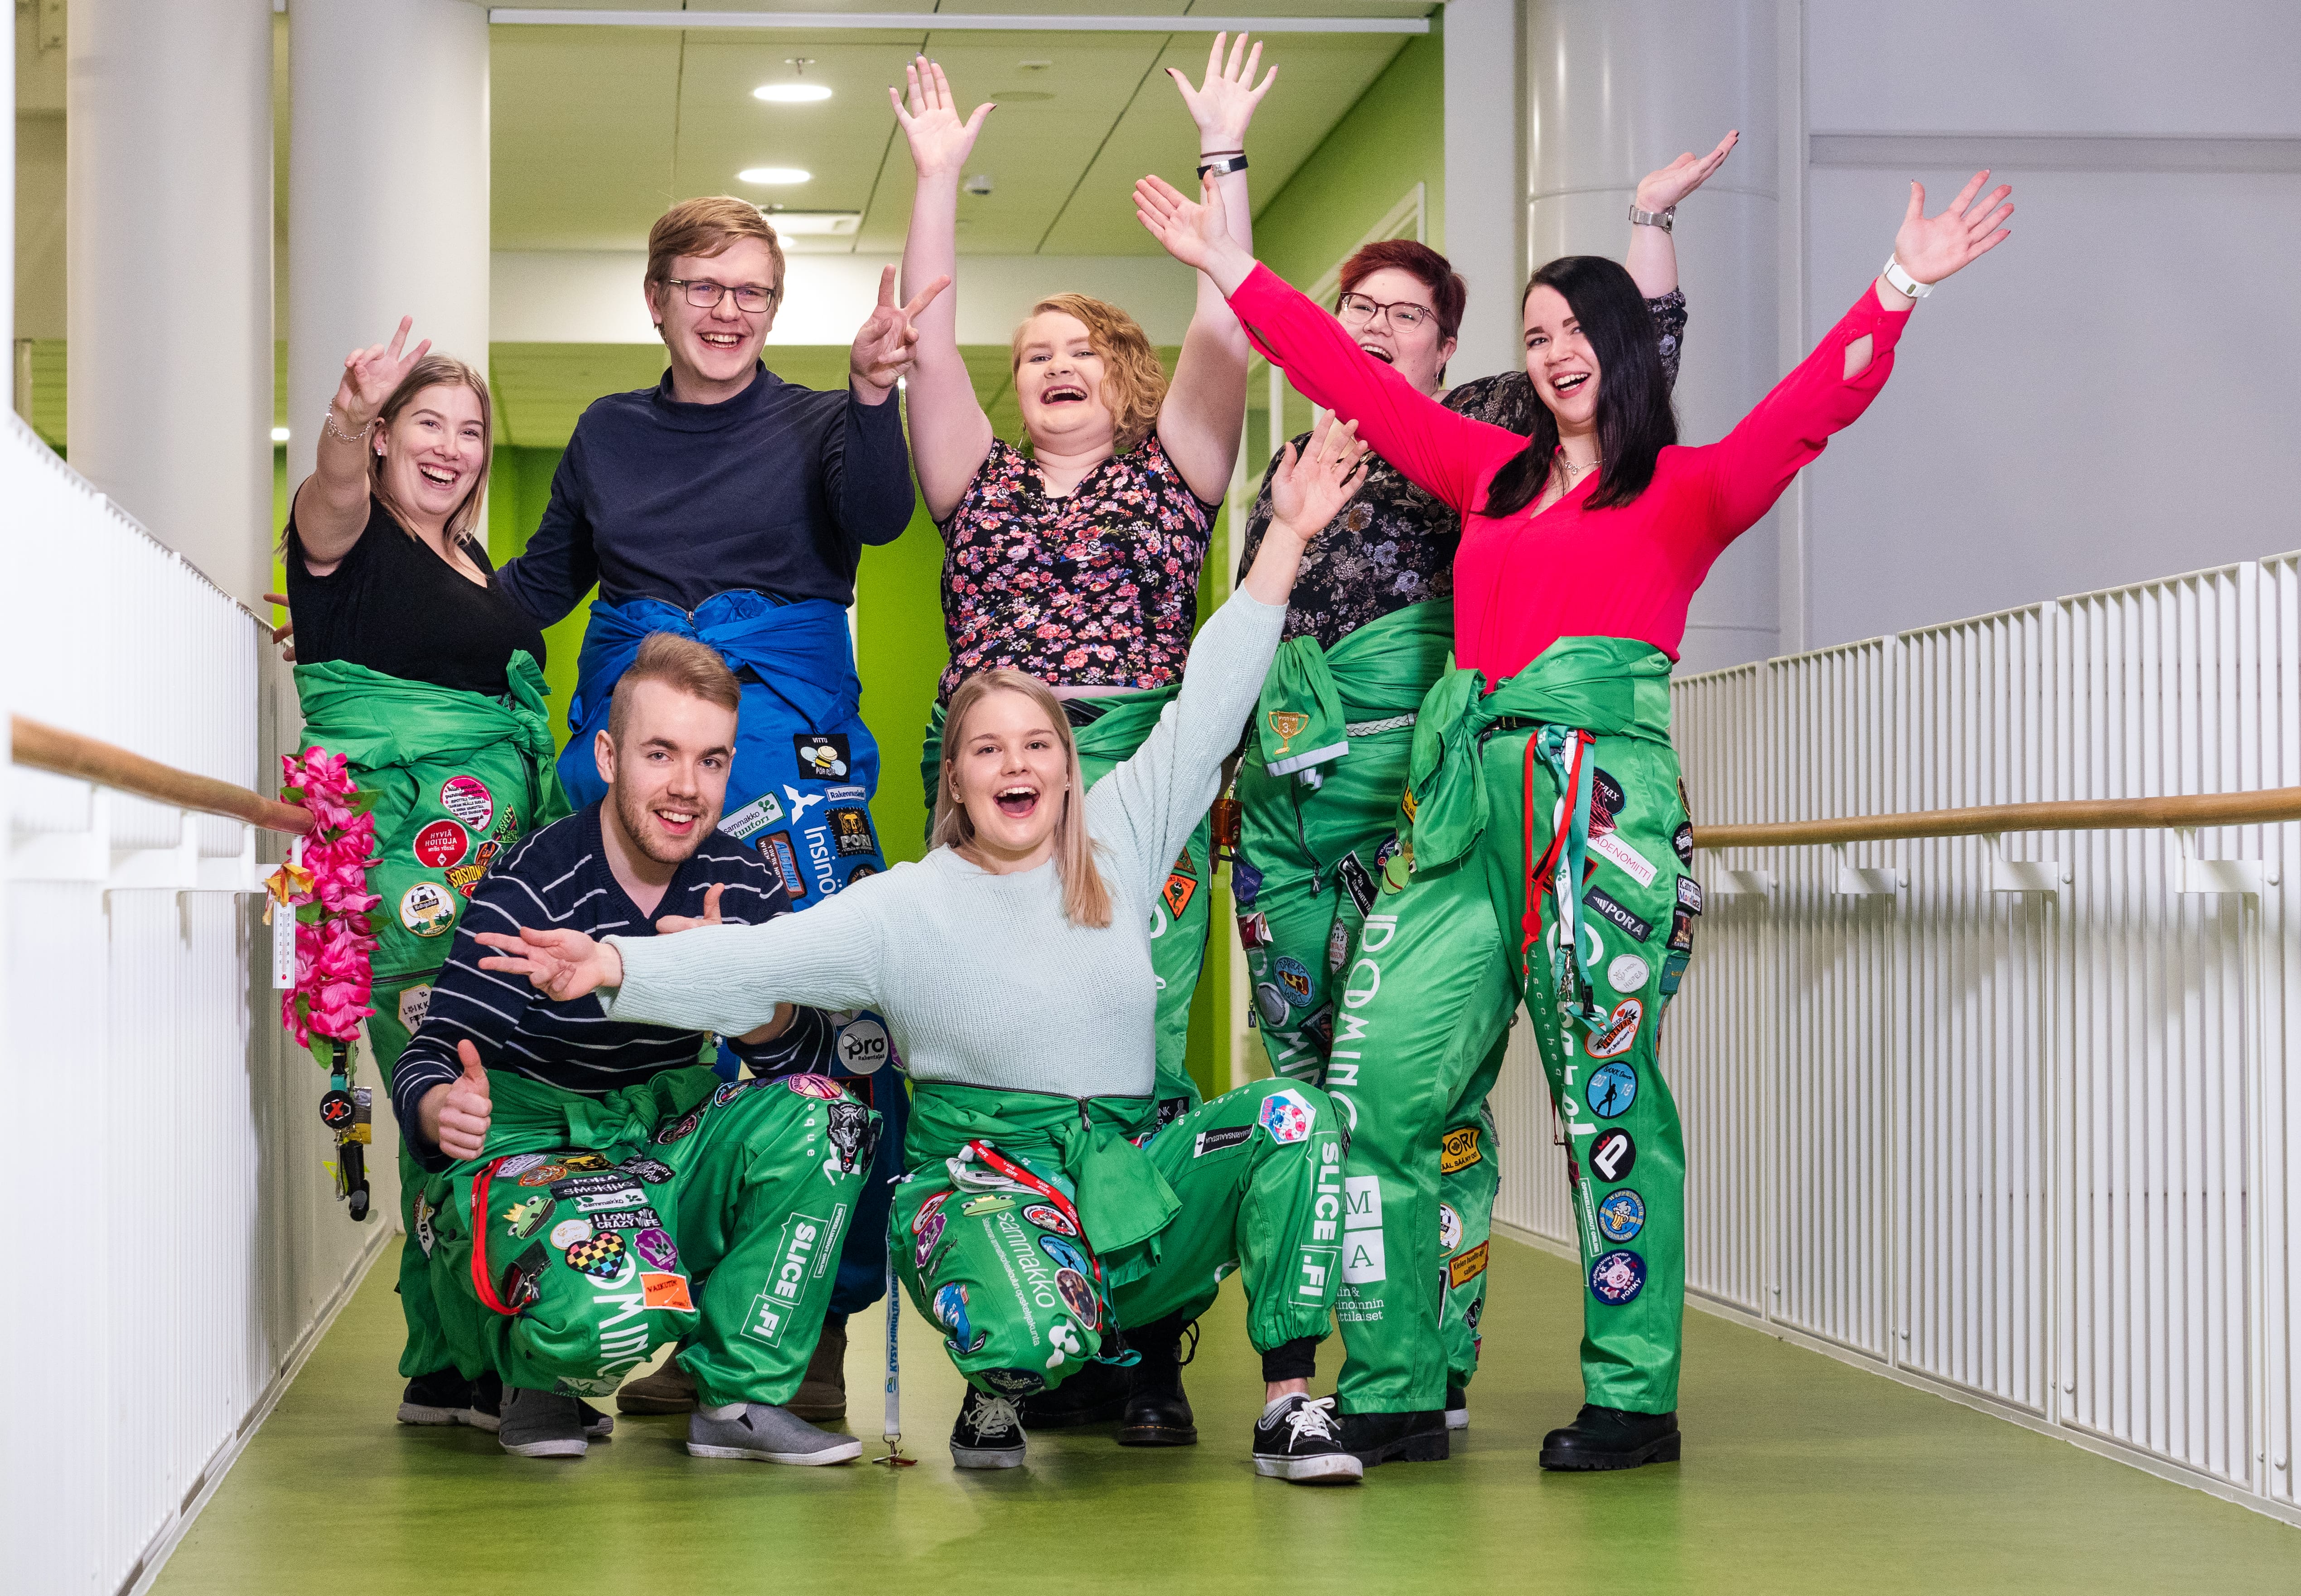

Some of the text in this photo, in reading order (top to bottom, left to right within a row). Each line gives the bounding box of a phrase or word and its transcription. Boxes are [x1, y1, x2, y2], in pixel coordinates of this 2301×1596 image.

[1282, 722, 1289, 733] 3
[430, 829, 452, 839] HYVIÄ
[724, 811, 760, 834] sammakko
[733, 815, 770, 838] tuutori
[425, 837, 457, 847] HOITOJA
[840, 834, 872, 848] PORI
[1679, 878, 1692, 892] Kato
[1605, 903, 1645, 936] PORA
[1602, 1017, 1632, 1049] FOREVER
[1441, 1162, 1454, 1171] ÄÄL
[563, 1180, 636, 1195] SMOKING
[1313, 1141, 1340, 1241] SLICE
[582, 1199, 624, 1208] sammakko
[1345, 1190, 1372, 1215] M
[596, 1217, 661, 1229] CRAZY WIFE
[603, 1212, 635, 1221] LOVE
[774, 1222, 816, 1298] SLICE
[997, 1212, 1056, 1308] sammakko
[1349, 1244, 1374, 1268] A
[1453, 1259, 1466, 1271] Kielen
[1299, 1255, 1325, 1297] .FI
[1620, 1277, 1642, 1301] PORKY
[1336, 1298, 1384, 1310] inoinnin
[890, 1300, 899, 1344] MINULTA
[1015, 1289, 1040, 1347] opiskelijakunta
[889, 1345, 898, 1372] KYSY
